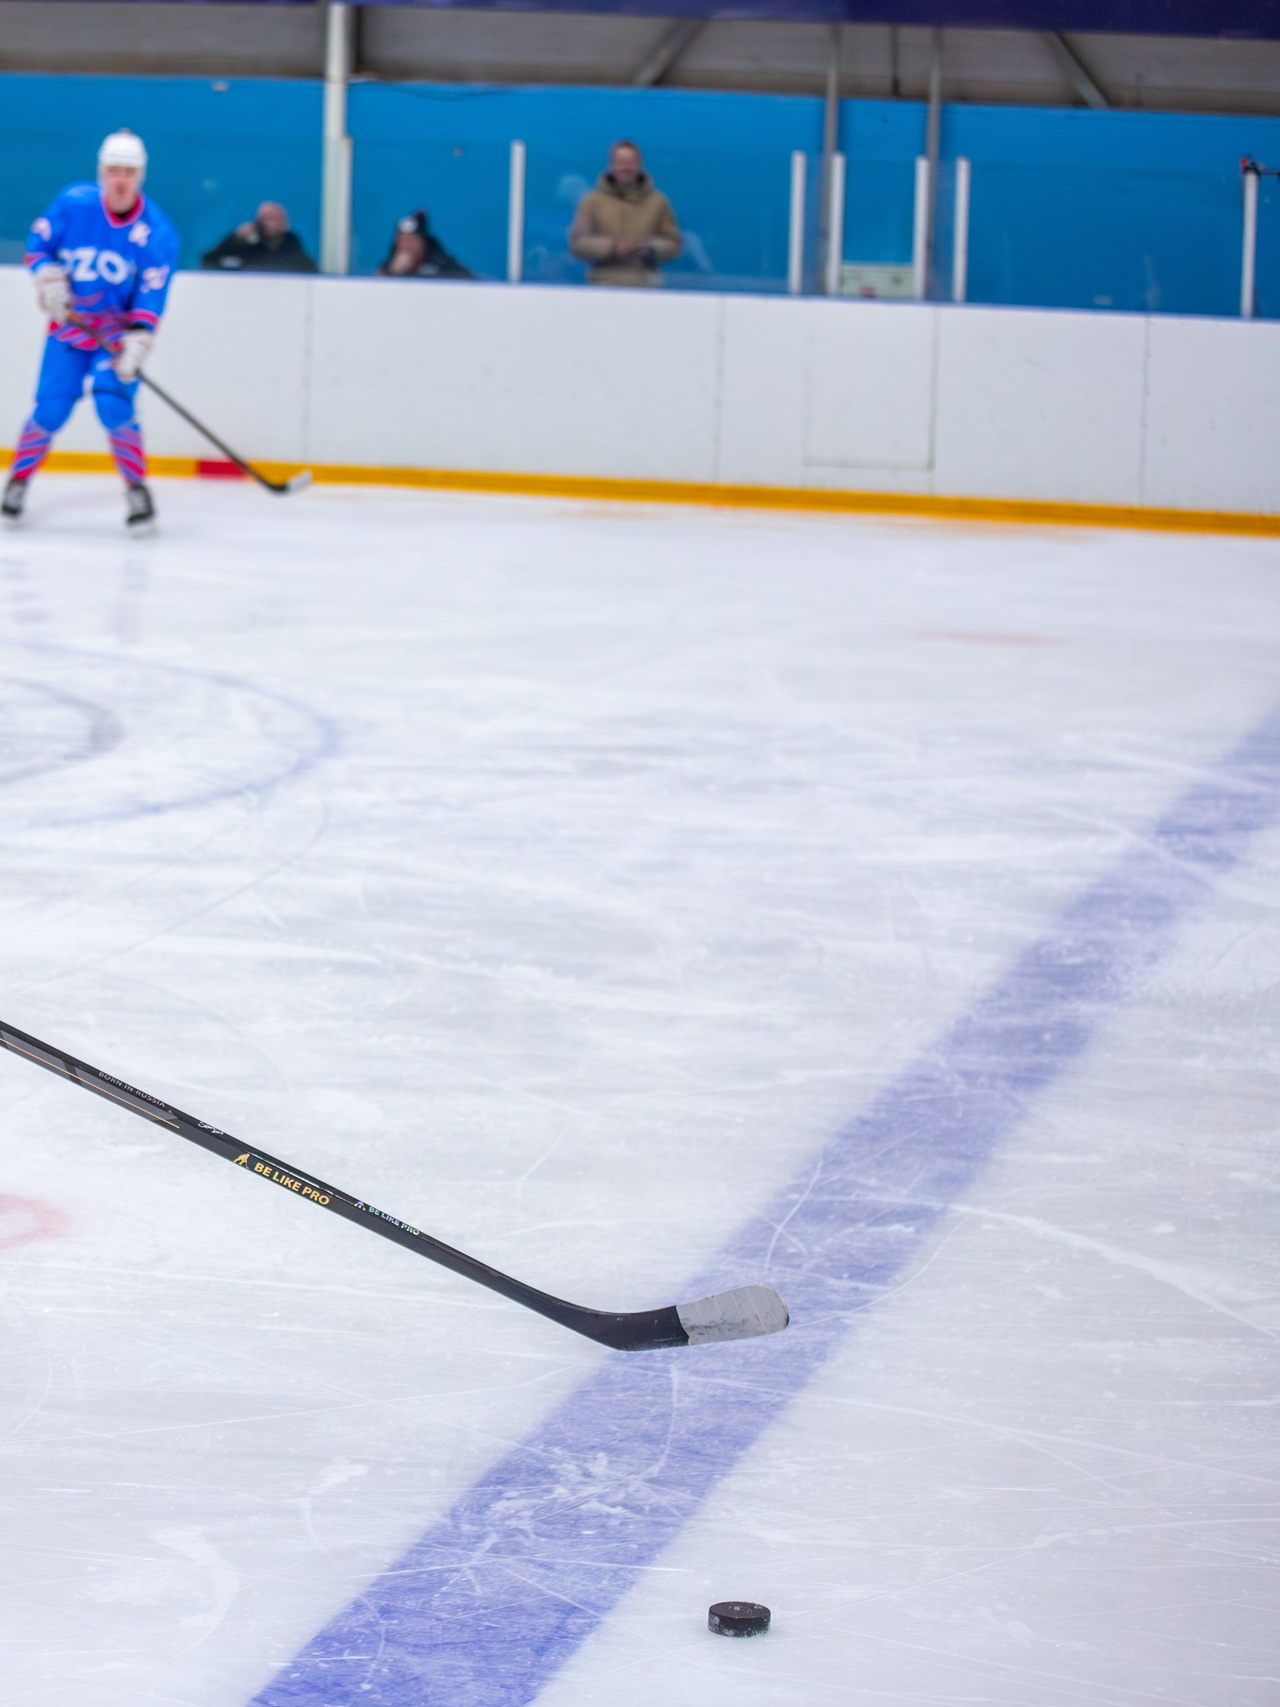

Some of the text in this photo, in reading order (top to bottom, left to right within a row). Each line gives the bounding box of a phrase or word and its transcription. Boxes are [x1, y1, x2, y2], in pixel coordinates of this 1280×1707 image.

[99, 1071, 166, 1108] BORN IN RUSSIA
[253, 1162, 330, 1206] BE LIKE PRO
[381, 1212, 400, 1226] LIKE
